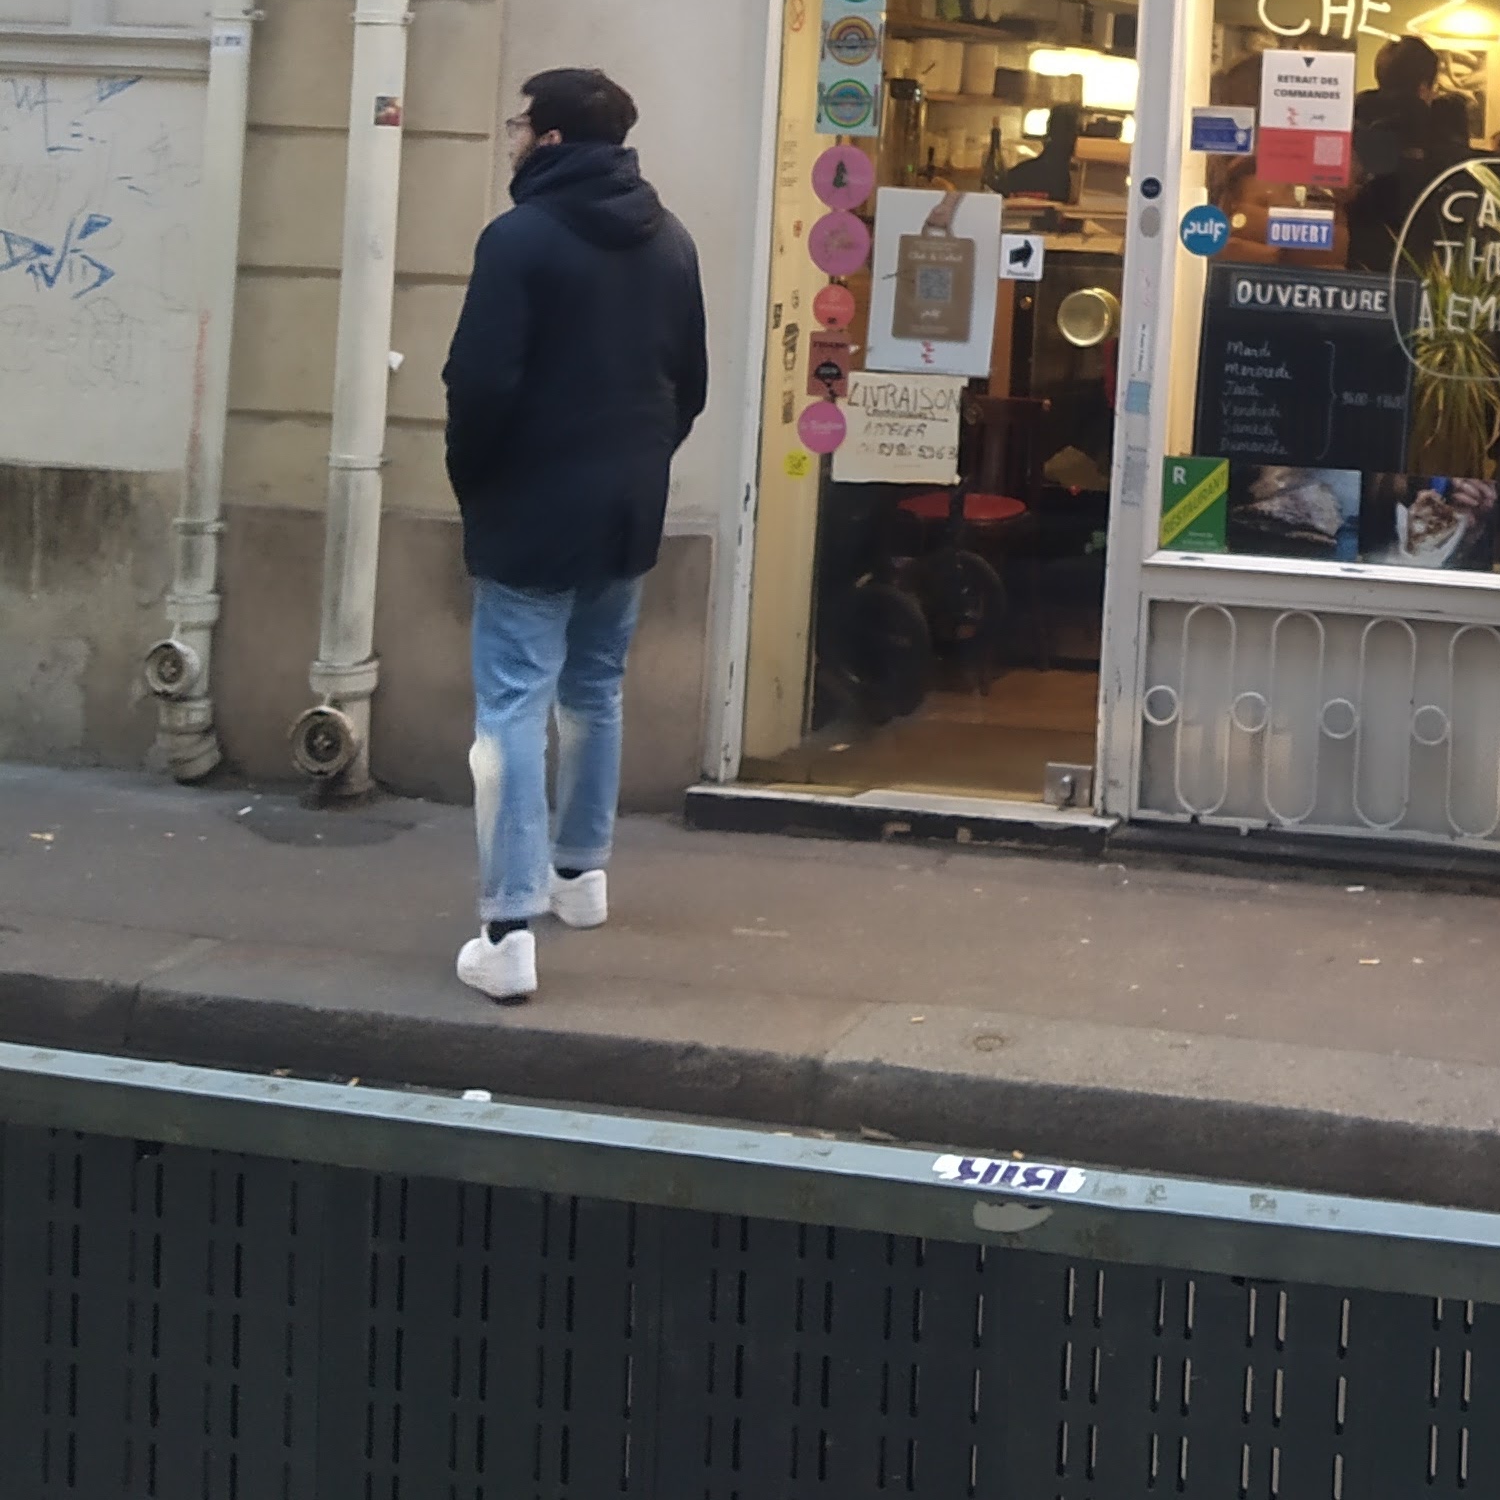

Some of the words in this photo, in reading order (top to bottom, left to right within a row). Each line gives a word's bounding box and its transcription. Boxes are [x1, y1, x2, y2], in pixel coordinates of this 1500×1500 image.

[1277, 74, 1318, 85] RETRAIT
[1320, 76, 1340, 86] DES
[1273, 88, 1341, 100] COMMANDES
[1271, 222, 1330, 244] OUVERT
[1236, 279, 1388, 312] OUVERTURE
[847, 382, 960, 412] LIVRAISON
[1172, 466, 1187, 485] R
